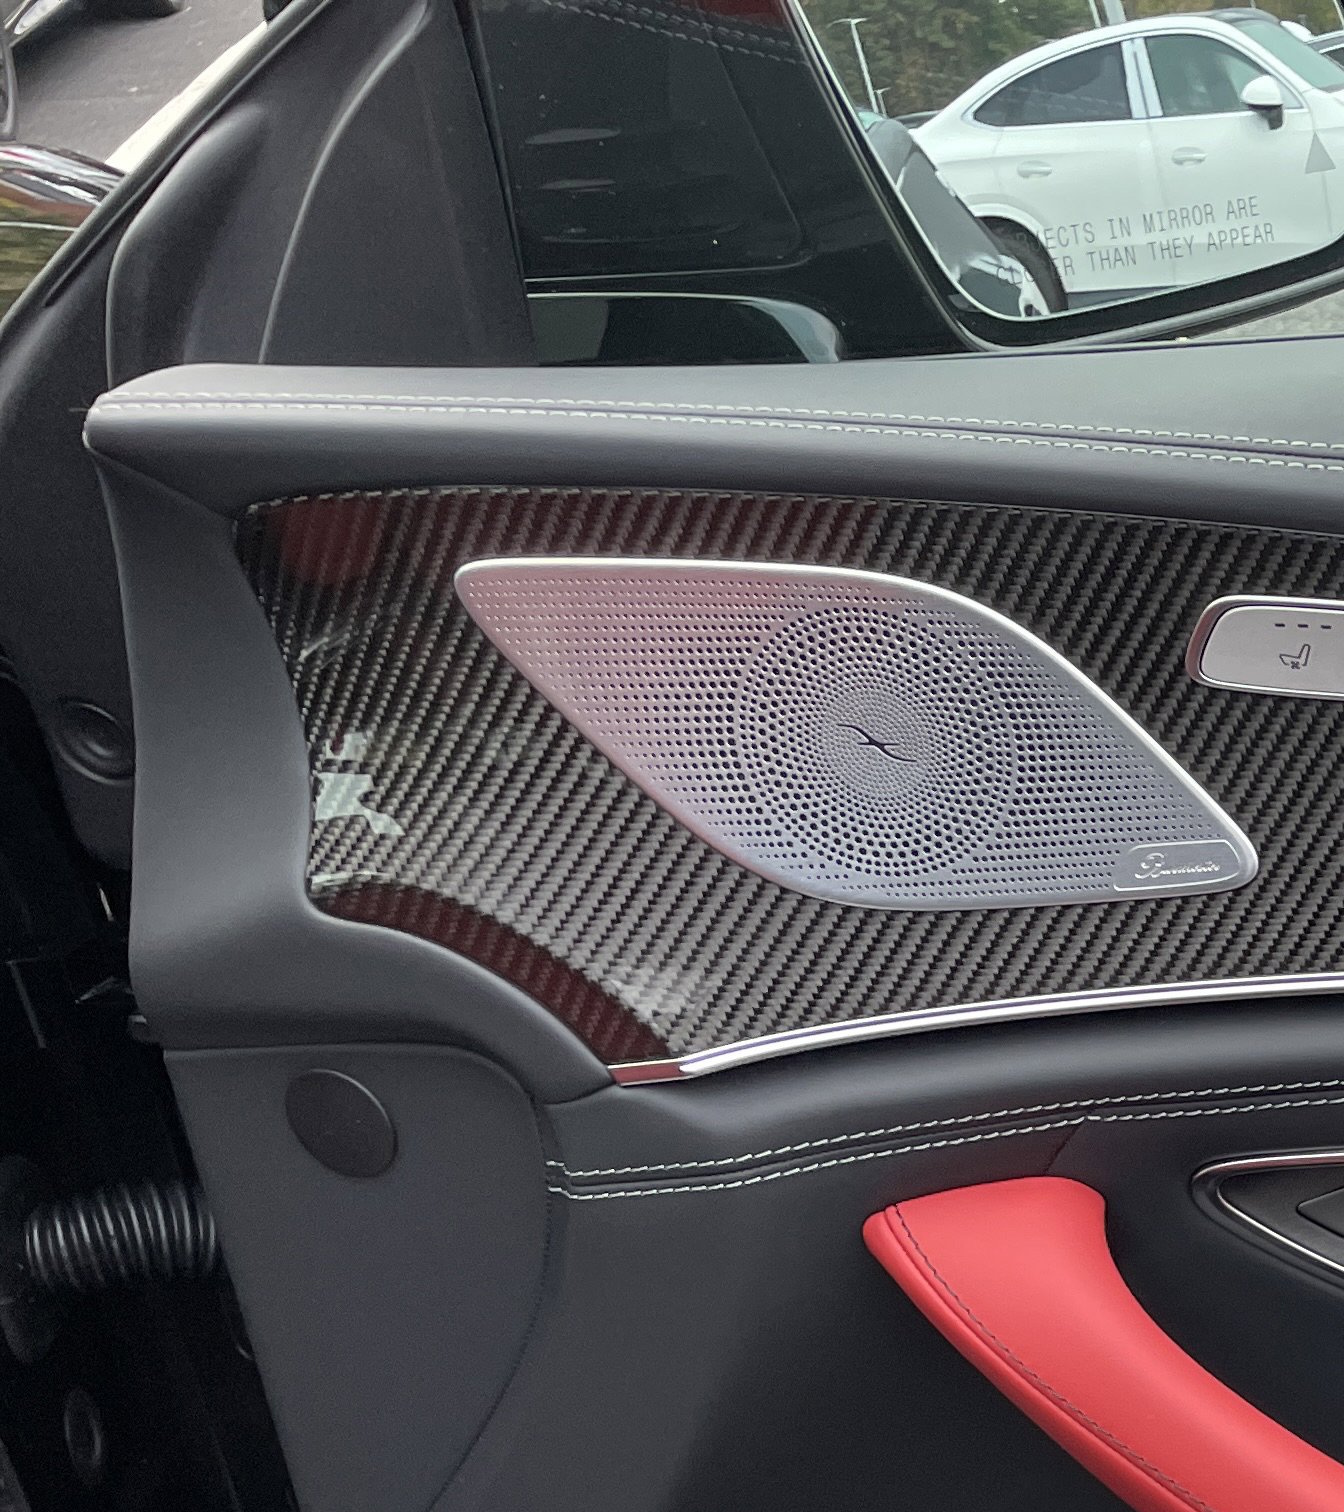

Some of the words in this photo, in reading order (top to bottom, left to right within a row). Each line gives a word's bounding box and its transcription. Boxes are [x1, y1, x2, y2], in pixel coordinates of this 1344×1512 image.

[1108, 217, 1131, 240] IN
[1143, 203, 1216, 234] MIRROR
[1226, 196, 1261, 221] ARE
[1088, 247, 1137, 273] THAN
[1148, 235, 1195, 261] THEY
[1207, 223, 1275, 252] APPEAR
